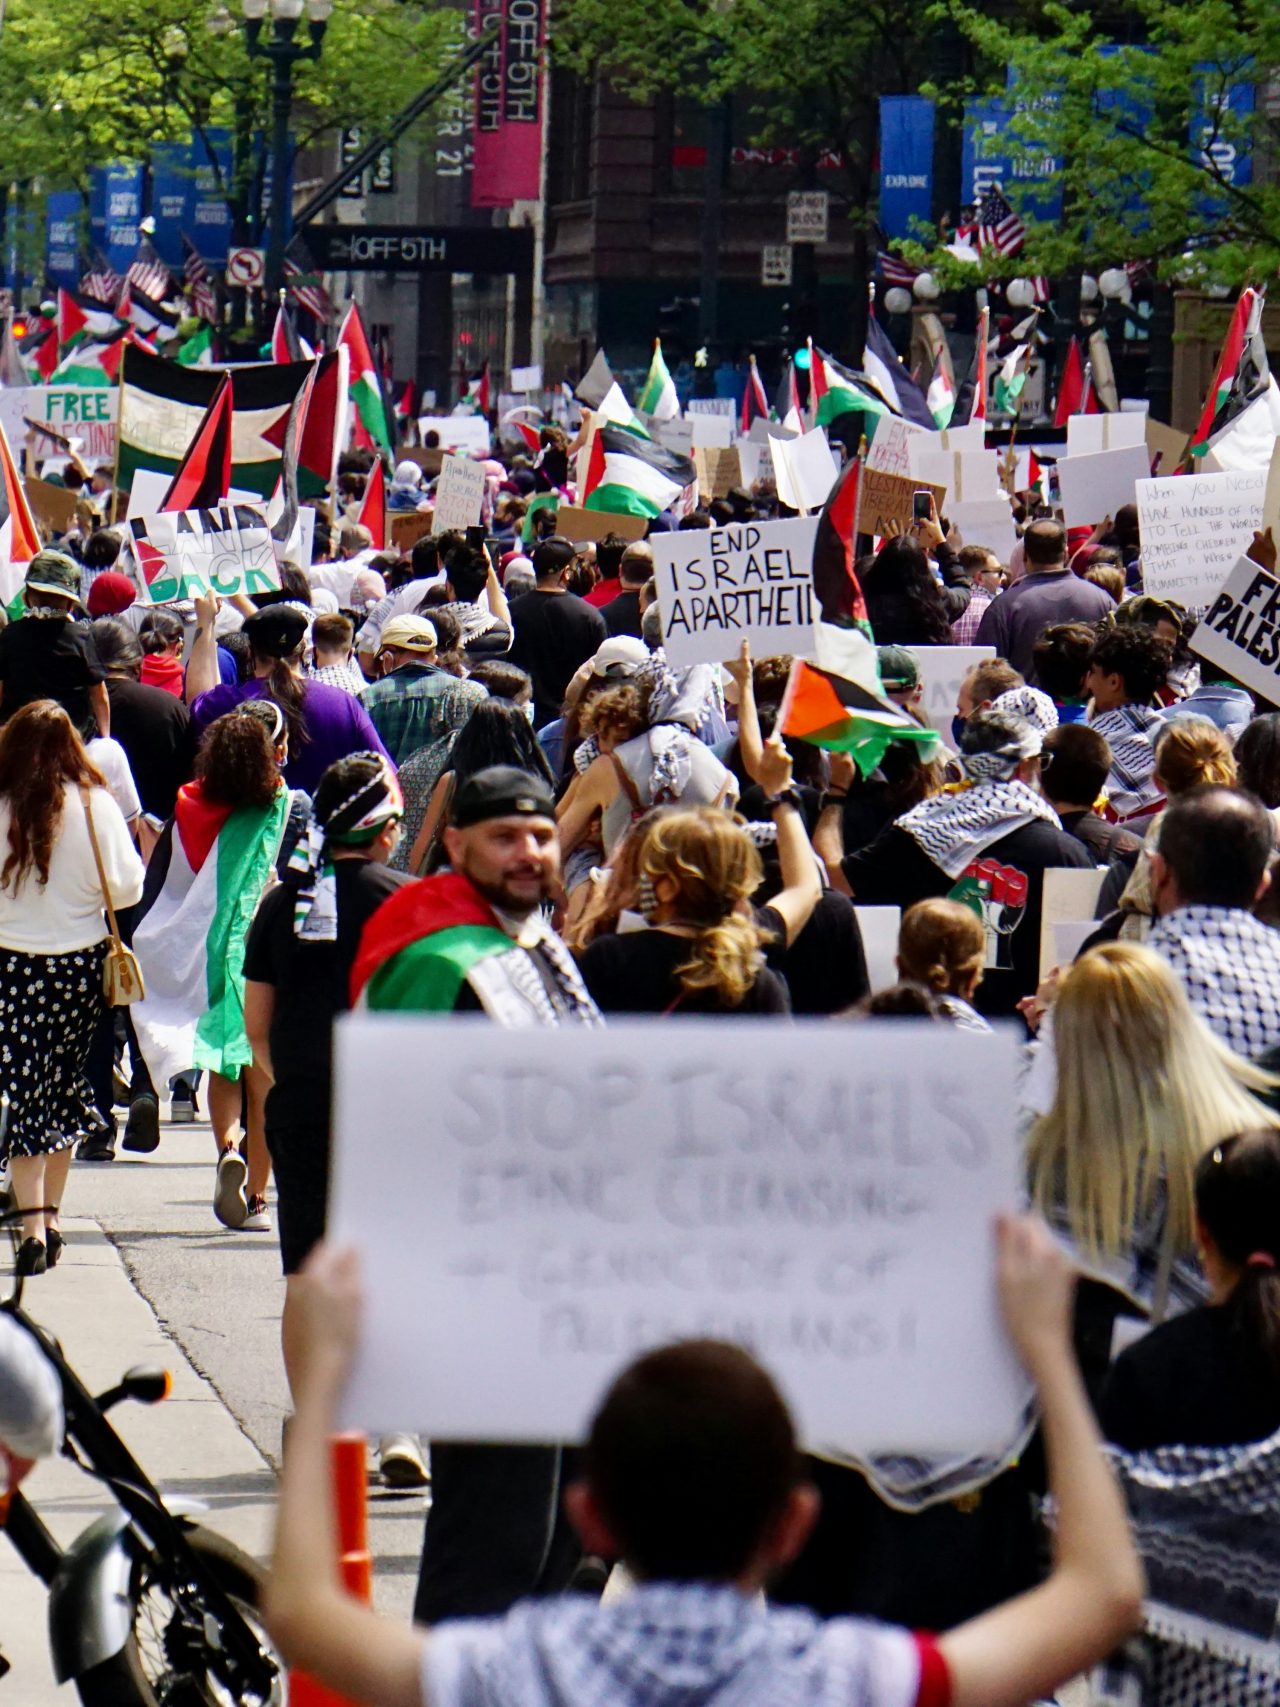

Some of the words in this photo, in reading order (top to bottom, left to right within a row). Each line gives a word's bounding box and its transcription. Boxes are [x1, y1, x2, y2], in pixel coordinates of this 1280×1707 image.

[436, 150, 463, 176] 21
[355, 237, 399, 260] OFF
[401, 237, 446, 261] 5TH
[46, 392, 111, 422] FREE
[130, 506, 270, 561] LAND
[710, 527, 760, 556] END
[1141, 525, 1166, 540] TO
[1230, 519, 1260, 530] WORLD
[142, 545, 278, 603] BACK
[671, 549, 810, 592] ISRAEL
[1204, 592, 1280, 676] PALES
[442, 1056, 646, 1152] STOP
